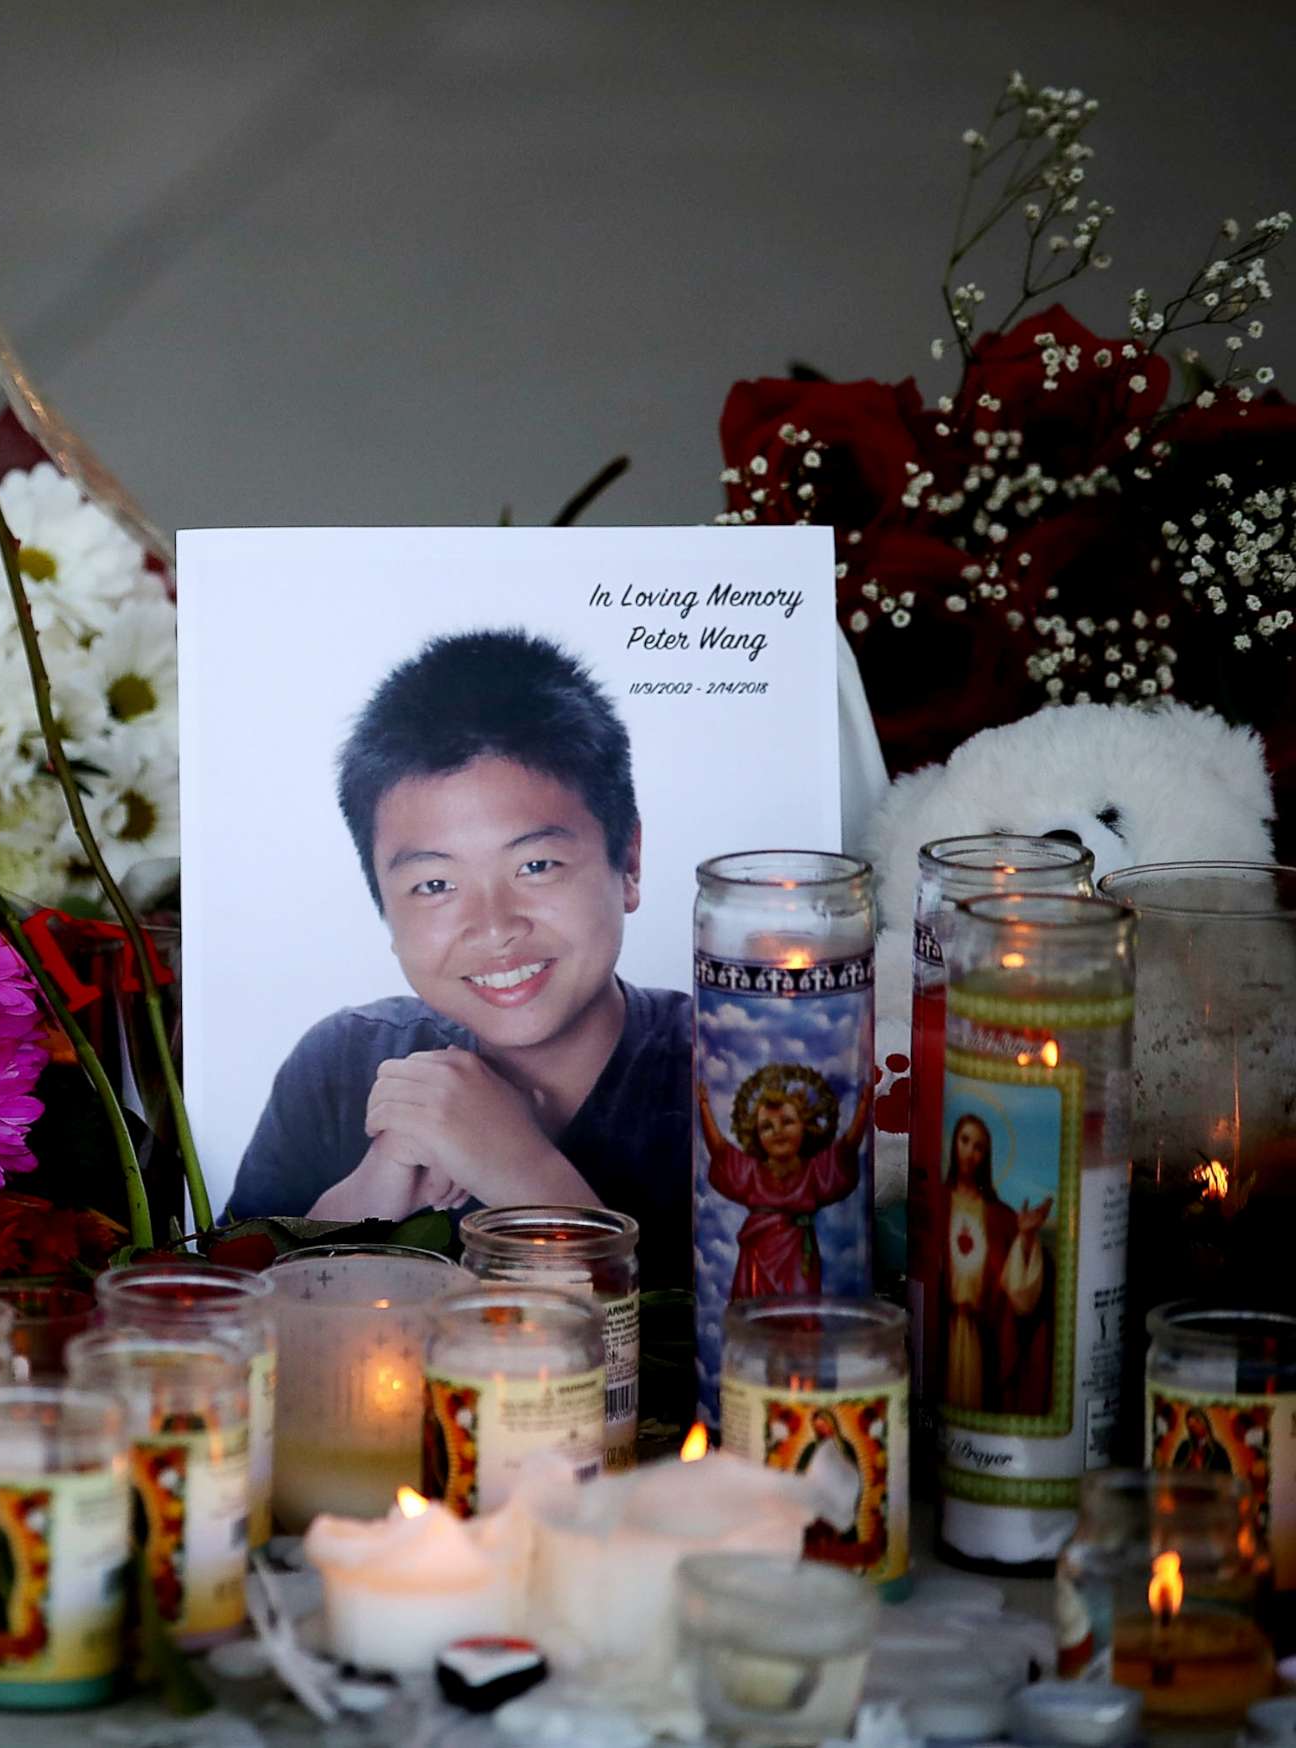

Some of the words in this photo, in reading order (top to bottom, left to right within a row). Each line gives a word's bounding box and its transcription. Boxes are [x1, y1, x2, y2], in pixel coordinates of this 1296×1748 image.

[589, 583, 613, 608] In
[620, 583, 700, 620] Loving
[706, 583, 804, 619] Memory
[626, 625, 690, 650] Peter
[699, 626, 768, 662] Wang
[628, 681, 693, 696] 11/9/2002
[705, 681, 769, 695] 2/14/2018
